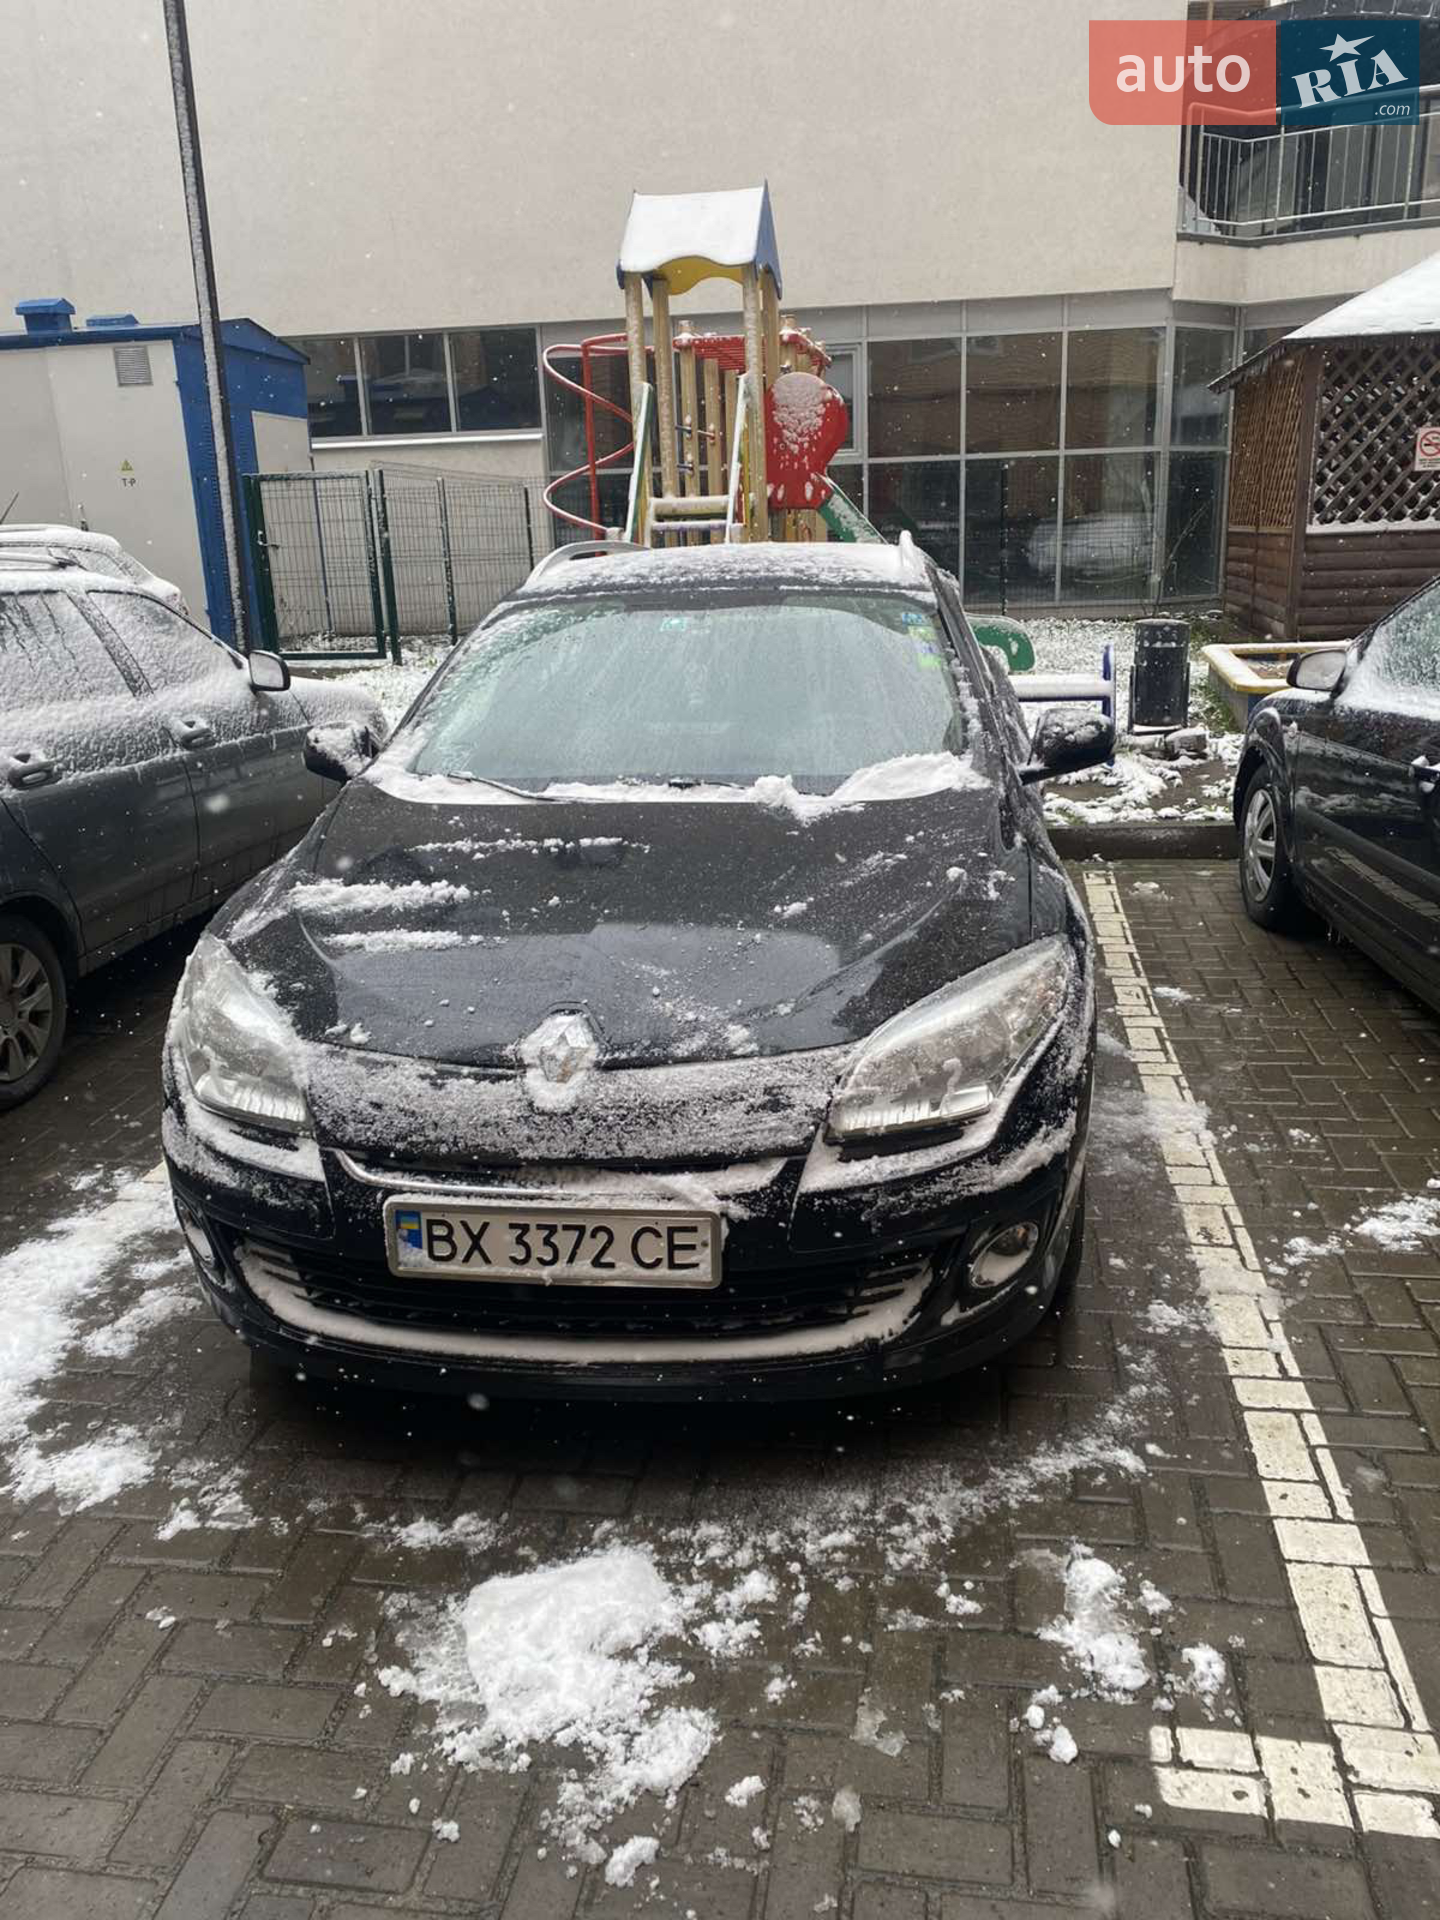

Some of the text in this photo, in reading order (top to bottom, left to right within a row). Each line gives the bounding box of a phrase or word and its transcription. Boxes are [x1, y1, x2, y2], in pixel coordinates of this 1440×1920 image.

[426, 1218, 700, 1270] BX 3372 CE
